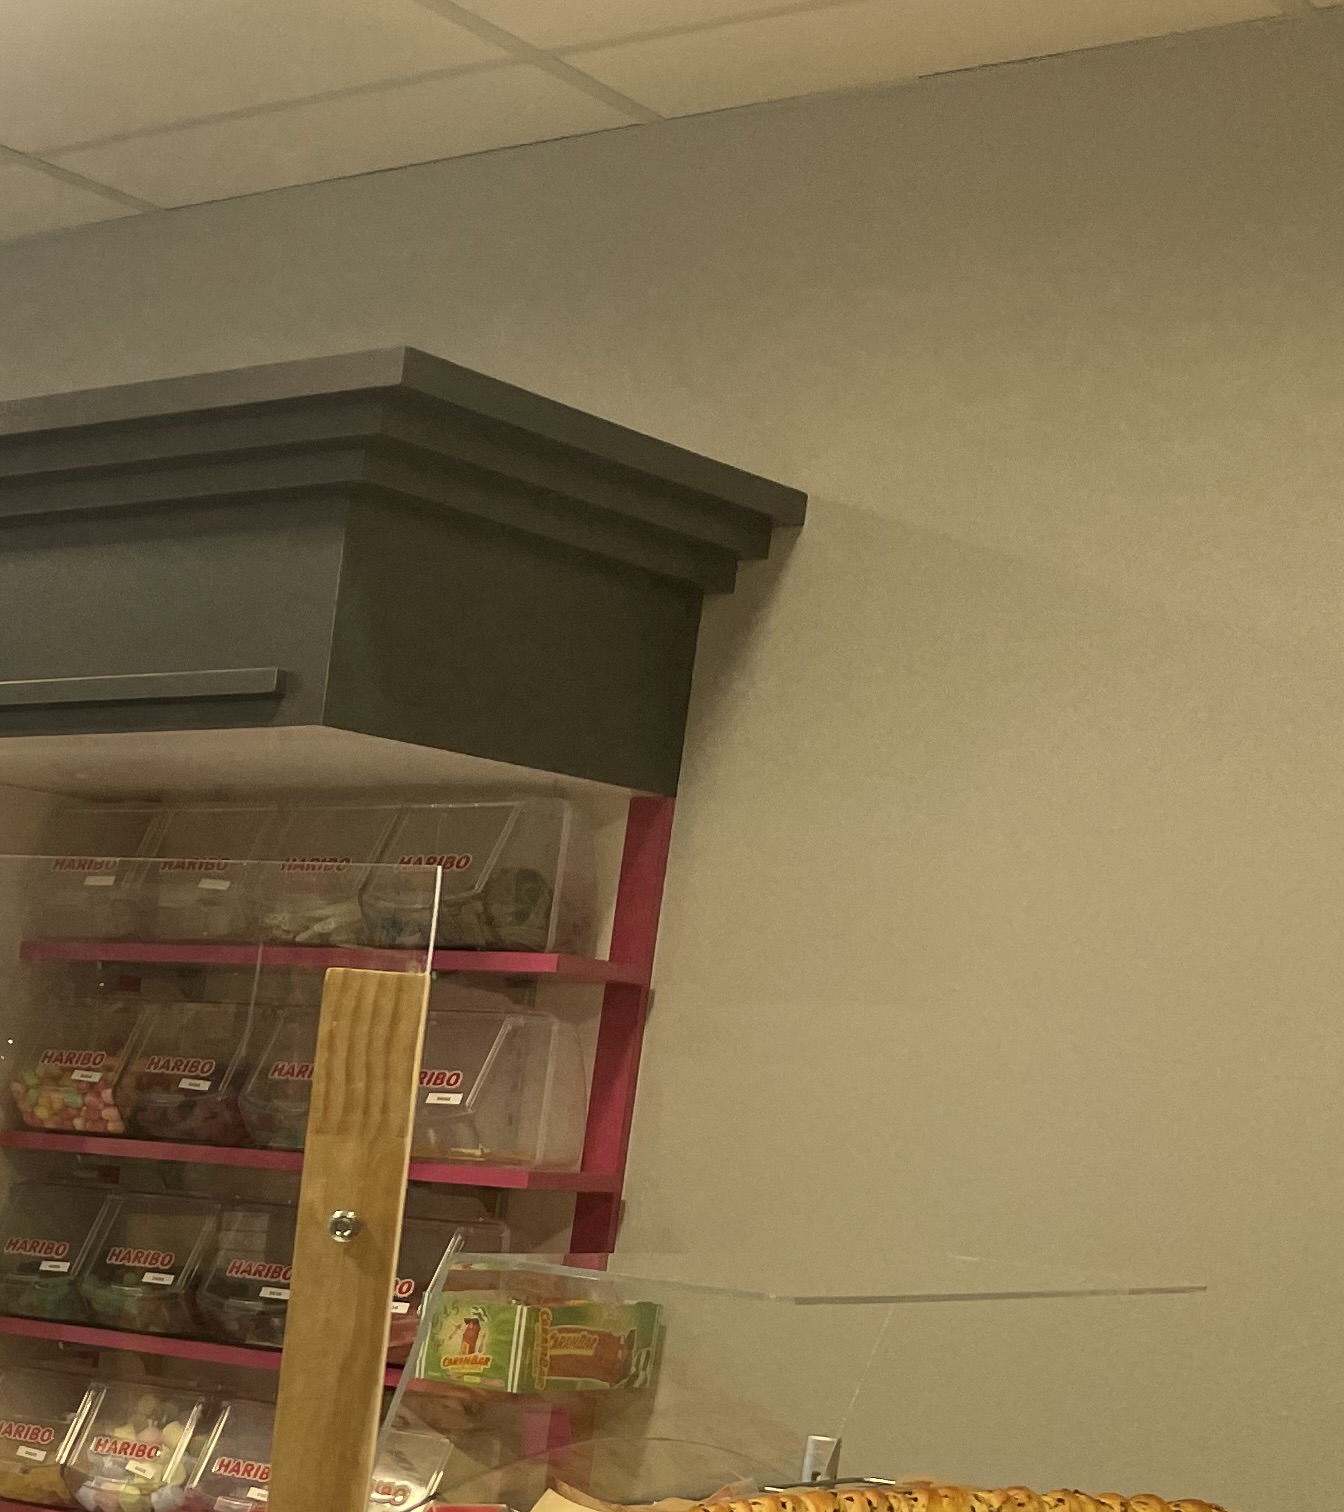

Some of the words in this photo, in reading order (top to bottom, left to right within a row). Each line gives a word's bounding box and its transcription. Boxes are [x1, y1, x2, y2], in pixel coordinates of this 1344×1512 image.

[398, 853, 471, 871] HARIBO
[41, 1050, 107, 1067] HARIBO
[146, 1055, 215, 1075] HARIBO
[269, 1061, 313, 1080] HARI
[418, 1070, 463, 1087] RIBO
[5, 1238, 69, 1258] HARIBO
[107, 1248, 175, 1269] HARIBO
[92, 1437, 162, 1461] HARIBO
[213, 1457, 270, 1482] HARIB
